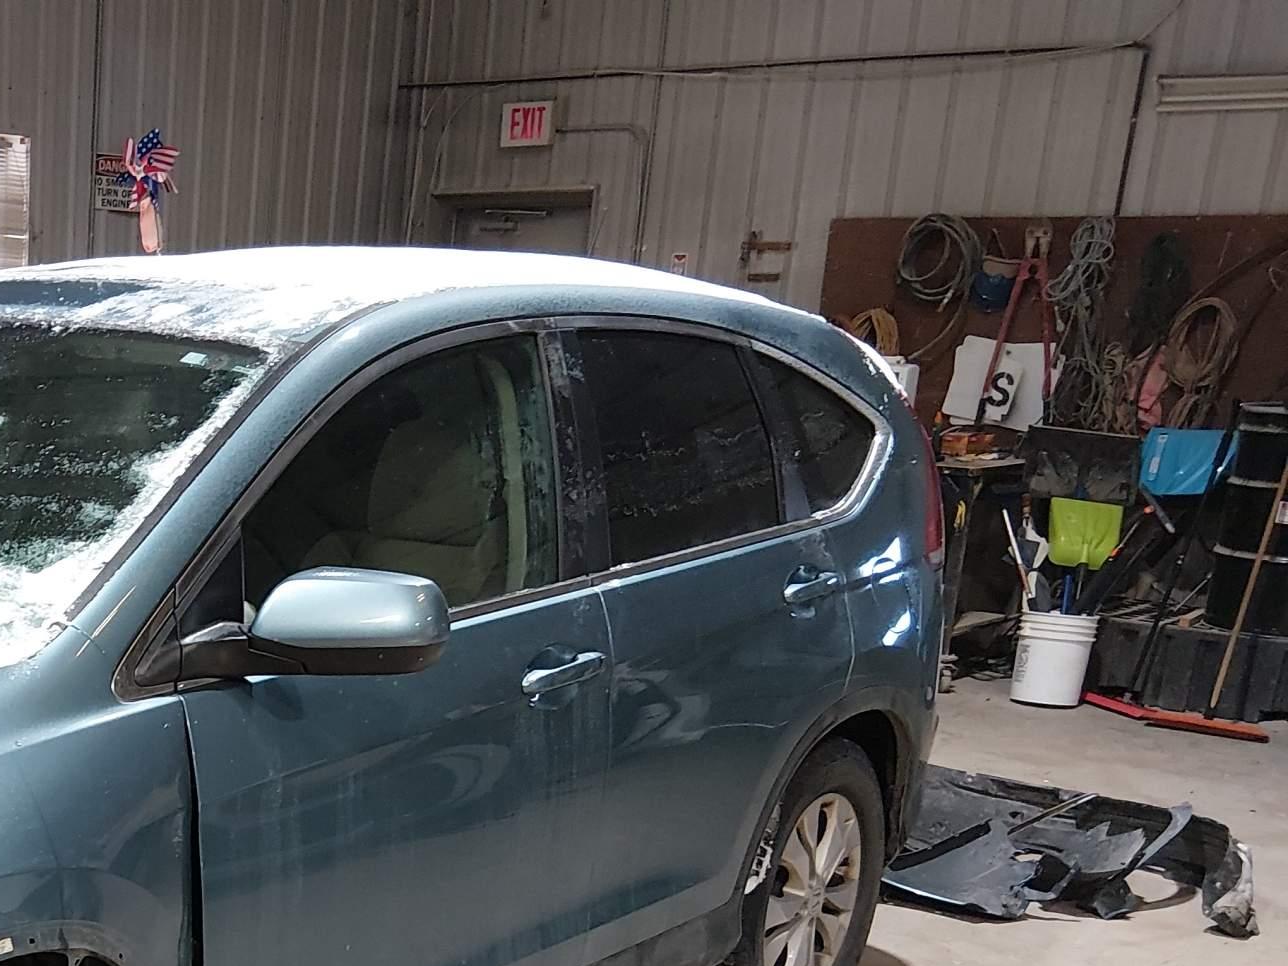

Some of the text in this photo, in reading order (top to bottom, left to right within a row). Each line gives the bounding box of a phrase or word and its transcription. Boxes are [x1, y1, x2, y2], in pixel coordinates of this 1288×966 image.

[510, 106, 546, 140] EXIT
[98, 159, 129, 172] DANG
[98, 187, 118, 198] TURN
[985, 371, 1015, 407] S
